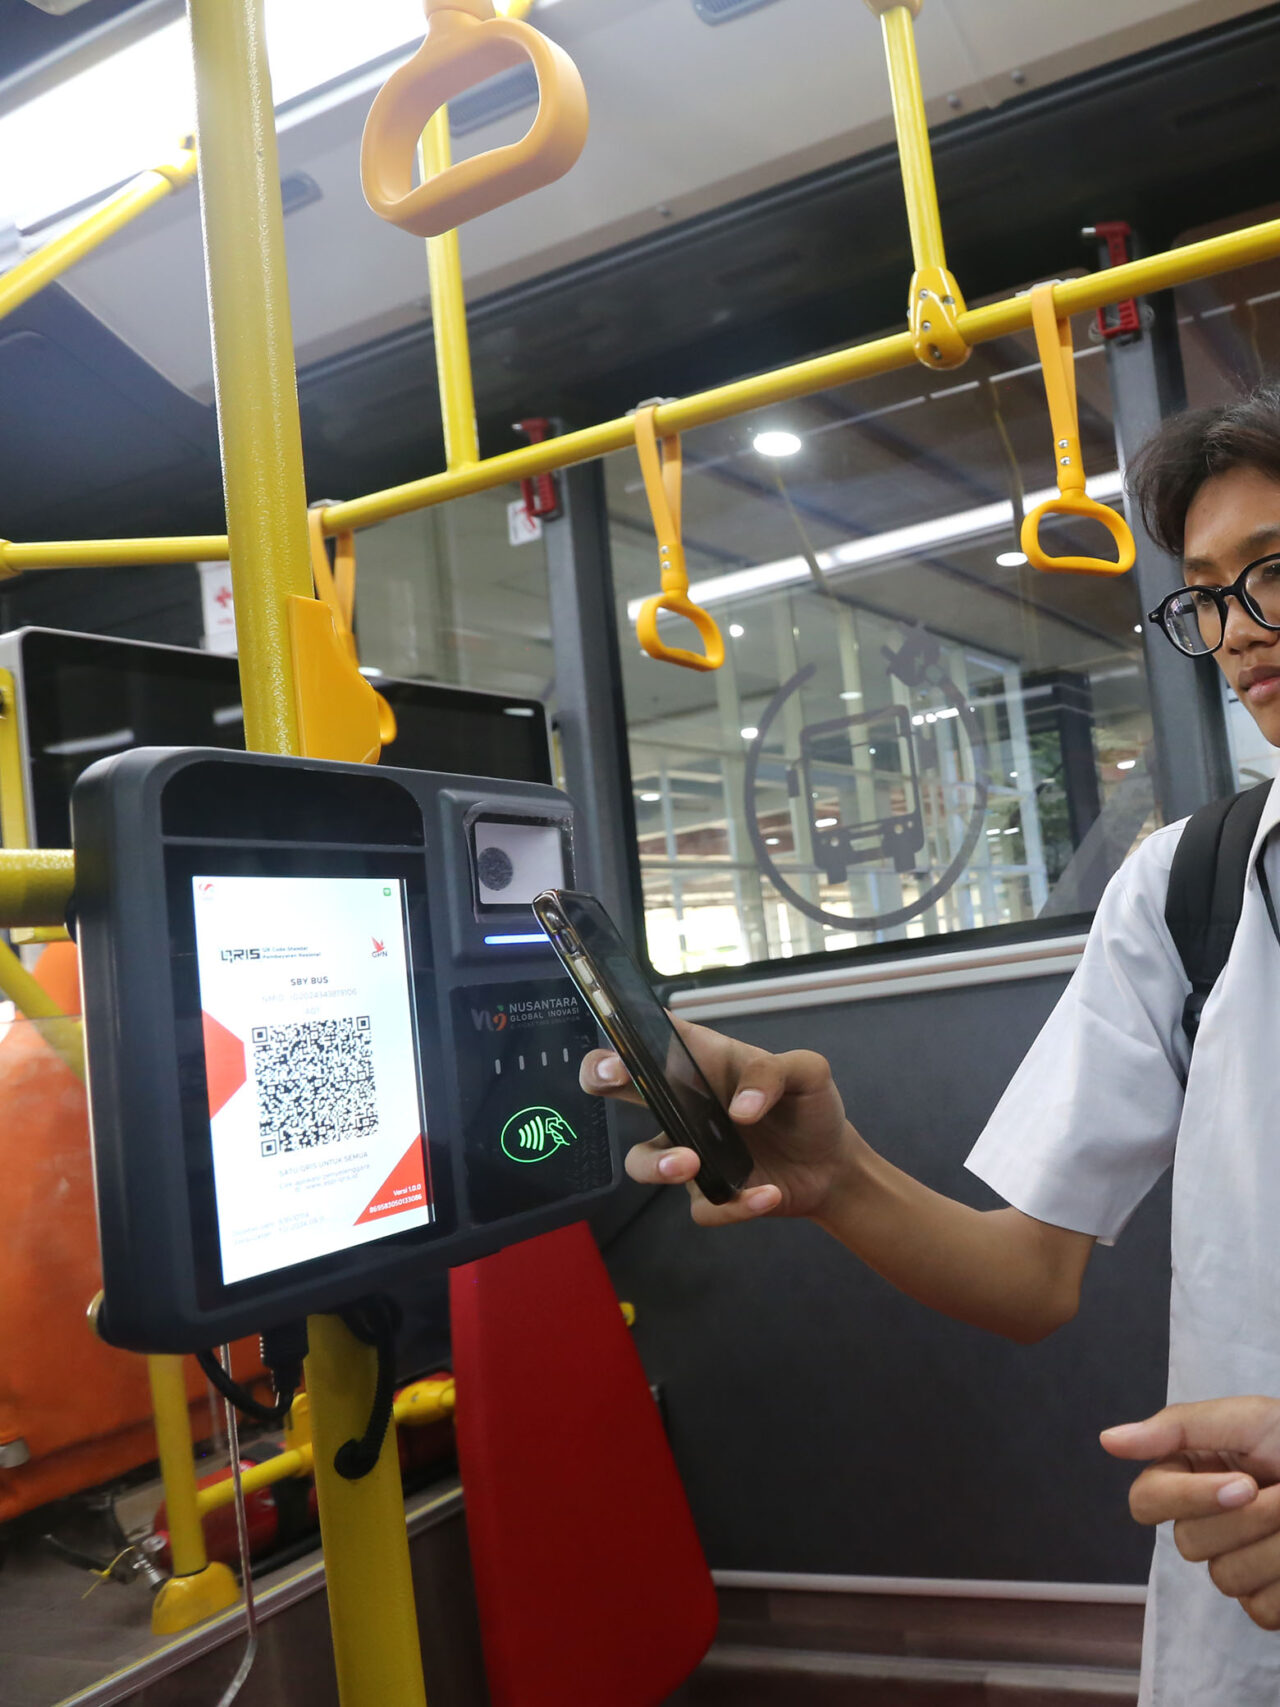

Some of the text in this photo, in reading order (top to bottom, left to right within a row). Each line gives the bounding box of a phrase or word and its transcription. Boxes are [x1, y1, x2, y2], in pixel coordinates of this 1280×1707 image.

[220, 948, 261, 963] QRIS
[289, 975, 329, 986] SBY BUS
[509, 997, 578, 1013] NUSANTARA
[510, 1009, 579, 1023] GLOBAL INOVASI
[392, 1186, 408, 1197] Versi
